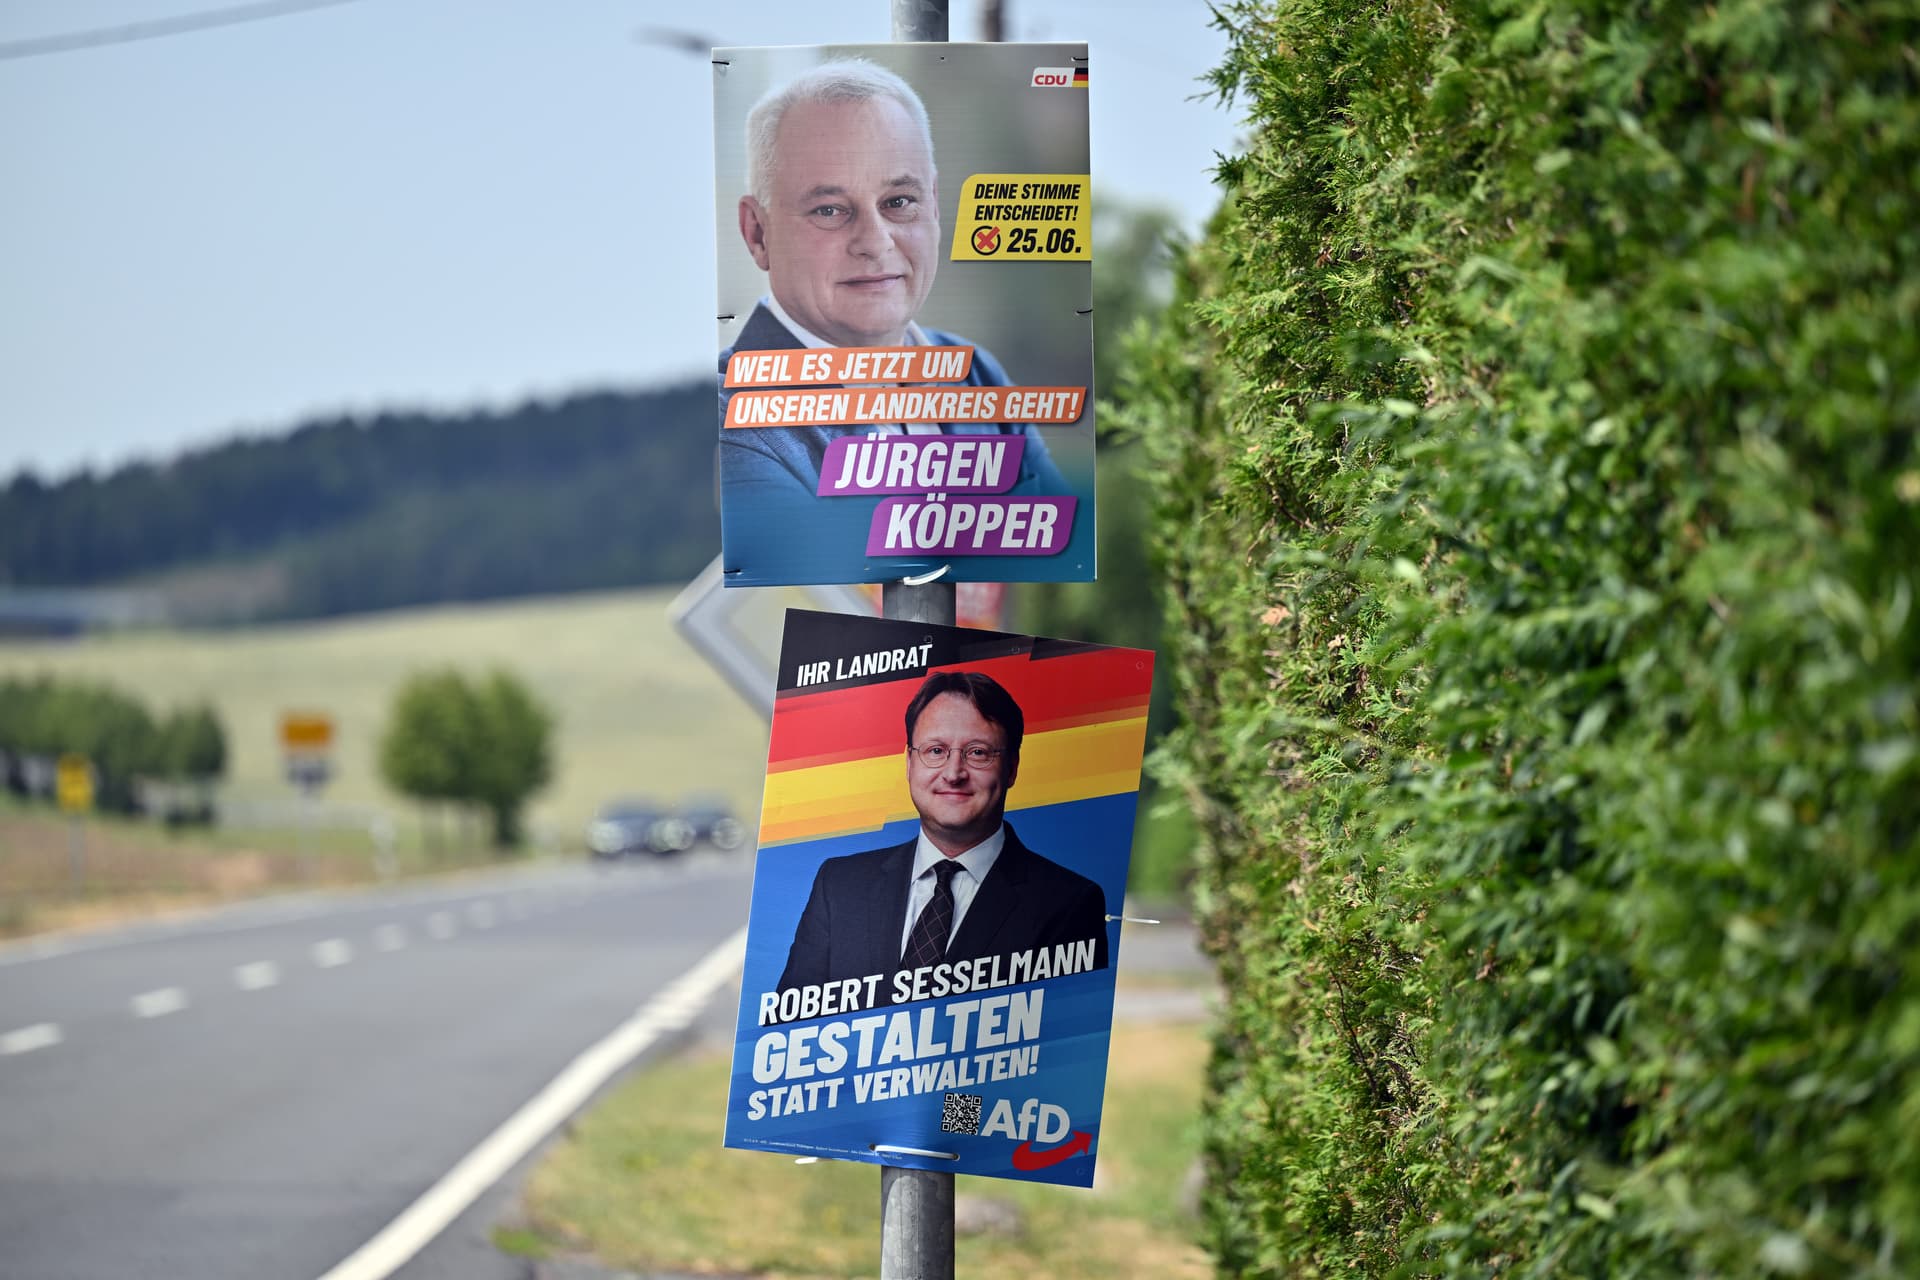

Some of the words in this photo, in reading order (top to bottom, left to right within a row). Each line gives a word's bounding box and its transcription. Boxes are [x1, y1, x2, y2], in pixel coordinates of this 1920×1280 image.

[1034, 74, 1068, 86] CDU
[974, 183, 1018, 199] DEINE
[1021, 183, 1081, 200] STIMME
[974, 205, 1079, 221] ENTSCHEIDET!
[1007, 228, 1082, 253] 25.06.
[733, 355, 792, 383] WEIL
[800, 354, 832, 381] ES
[838, 352, 915, 381] JETZT
[922, 351, 966, 378] UM
[734, 395, 850, 424] UNSEREN
[855, 391, 997, 420] LANDKREIS
[1003, 391, 1079, 419] GEHT!
[834, 432, 1006, 489] JÜRGEN
[884, 493, 1058, 549] KÖPPER
[796, 661, 831, 687] IHR
[836, 644, 932, 680] LANDRAT
[758, 974, 884, 1026] ROBERT
[891, 938, 1096, 1004] SESSELMANN
[752, 989, 1045, 1084] GESTALTEN
[747, 1077, 845, 1121] STATT
[854, 1045, 1040, 1104] VERWALTEN!
[981, 1098, 1071, 1144] AfD
